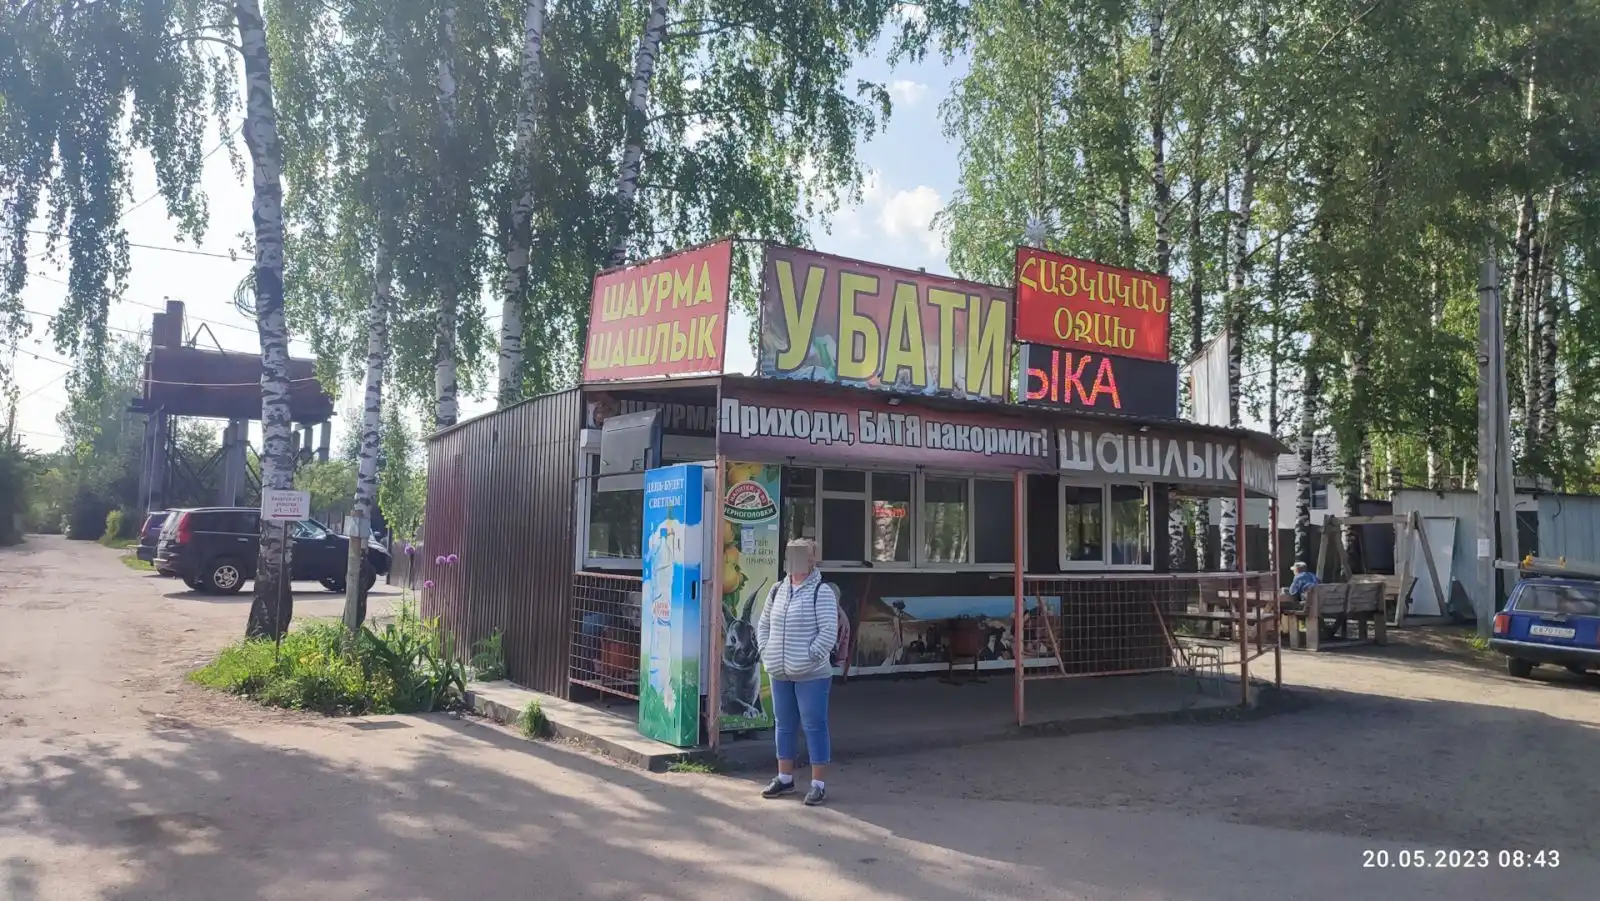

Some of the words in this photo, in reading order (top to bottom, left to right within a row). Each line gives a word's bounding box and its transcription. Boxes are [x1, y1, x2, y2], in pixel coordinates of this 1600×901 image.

[601, 260, 714, 323] ШАУРМА
[1018, 255, 1167, 314] ՀԱՅԿԱԿԱՆ
[589, 314, 719, 371] ШАШЛЫК
[774, 258, 827, 373] У
[836, 270, 1008, 398] БАТИ
[1052, 307, 1136, 350] ՕՋԱԽ
[720, 398, 855, 447] Приходи,
[859, 410, 920, 448] БАТЯ
[925, 420, 1049, 458] накормит!
